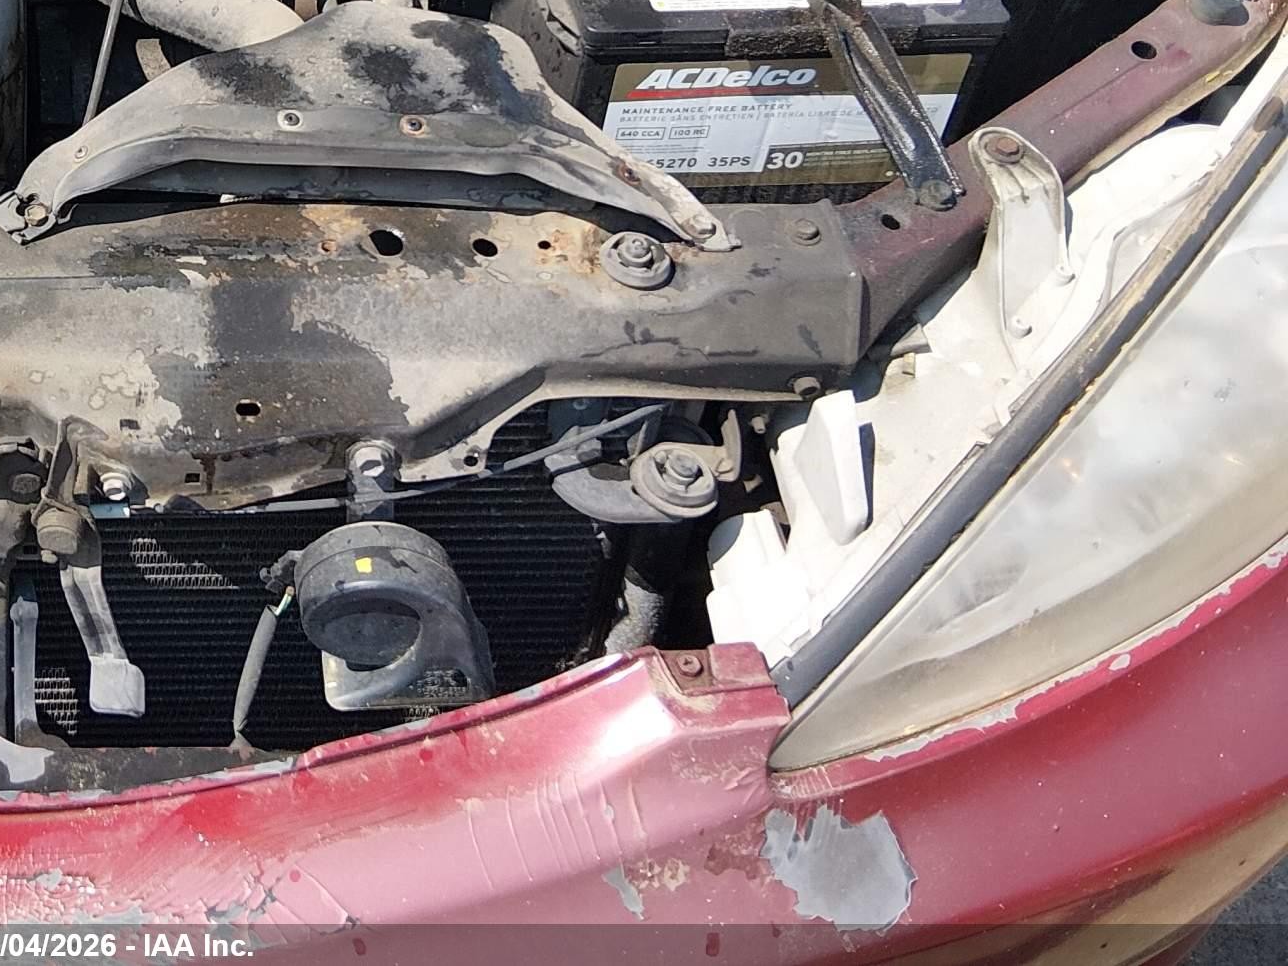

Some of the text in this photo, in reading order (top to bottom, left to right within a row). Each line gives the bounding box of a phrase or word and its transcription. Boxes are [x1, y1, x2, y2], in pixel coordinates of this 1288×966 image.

[635, 65, 817, 90] ACDelco
[622, 103, 793, 115] MAINTENANCE FREE BATTERY
[700, 113, 754, 121] ENTRETIEN
[707, 156, 752, 167] 35PS
[766, 151, 804, 170] 30
